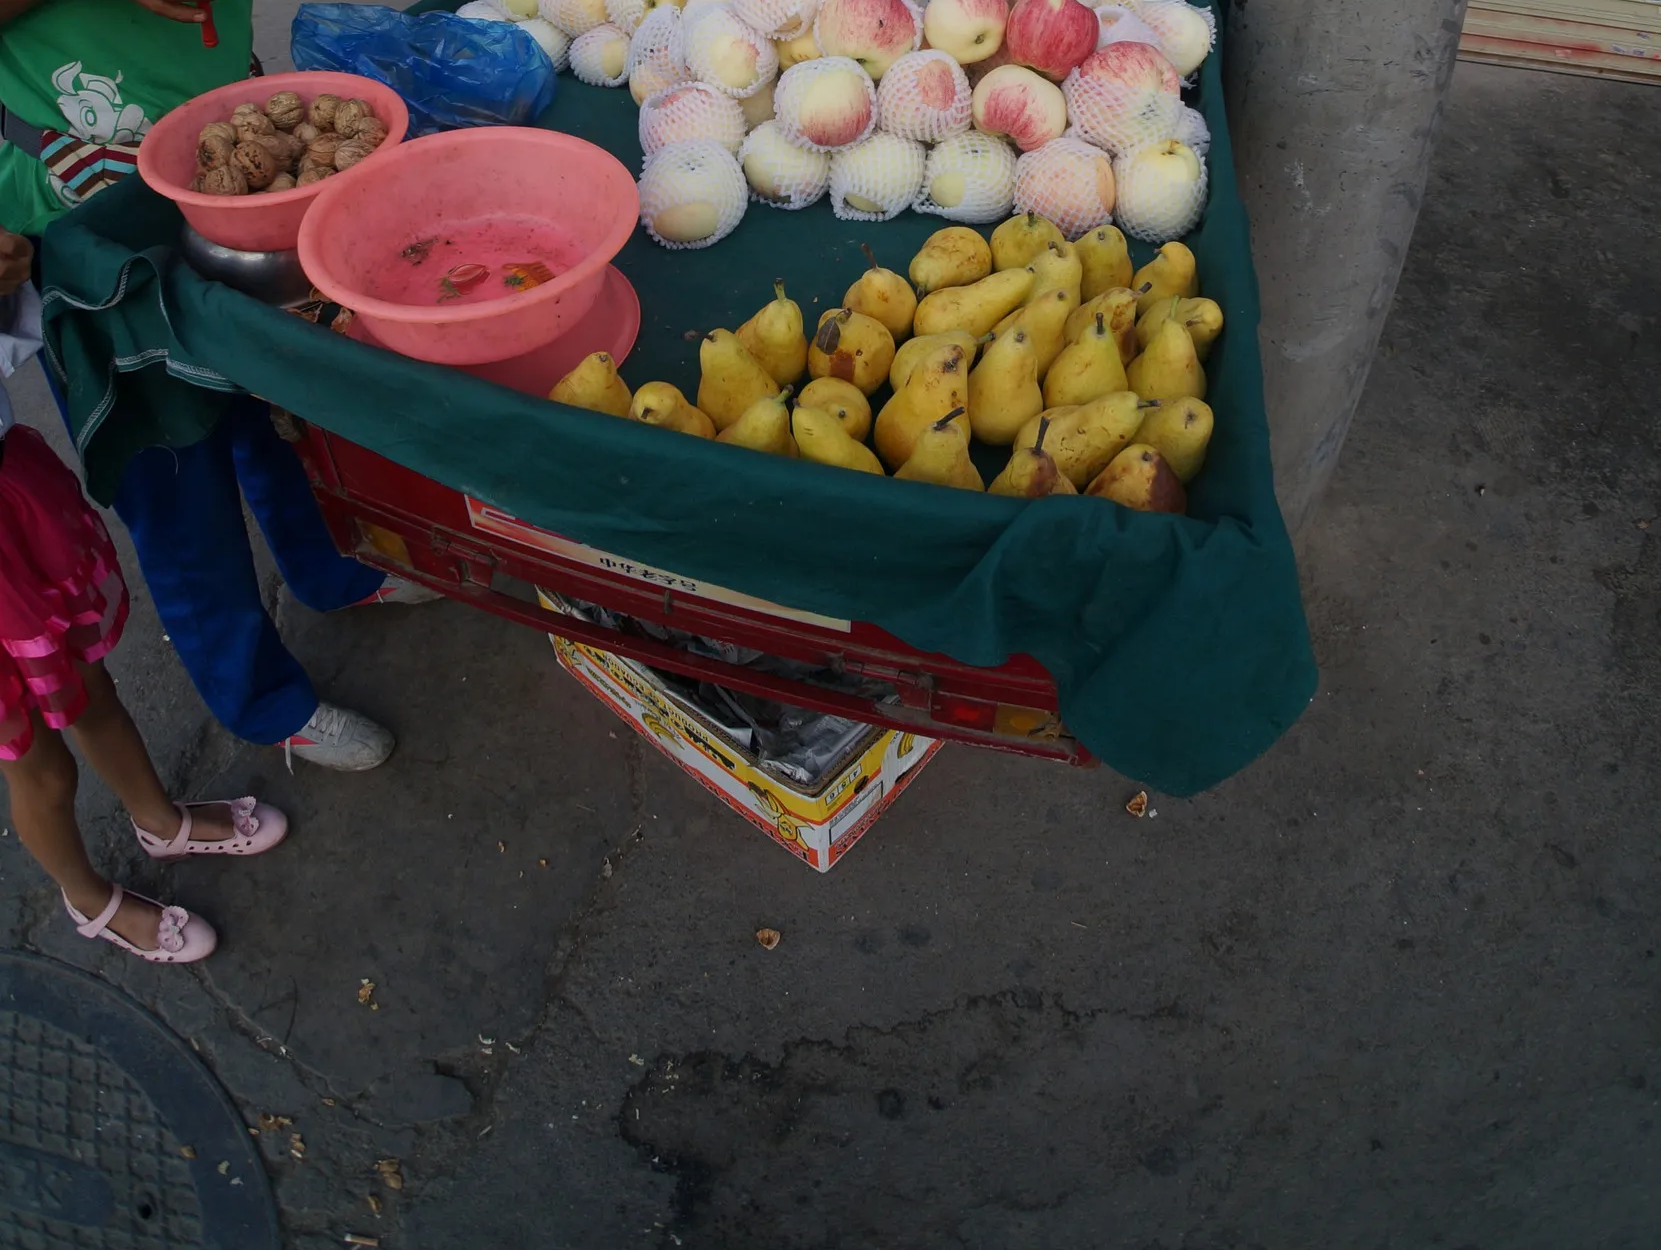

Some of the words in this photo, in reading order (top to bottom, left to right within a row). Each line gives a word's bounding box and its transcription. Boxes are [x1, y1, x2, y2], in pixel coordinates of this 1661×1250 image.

[599, 557, 697, 592] 中华老字号
